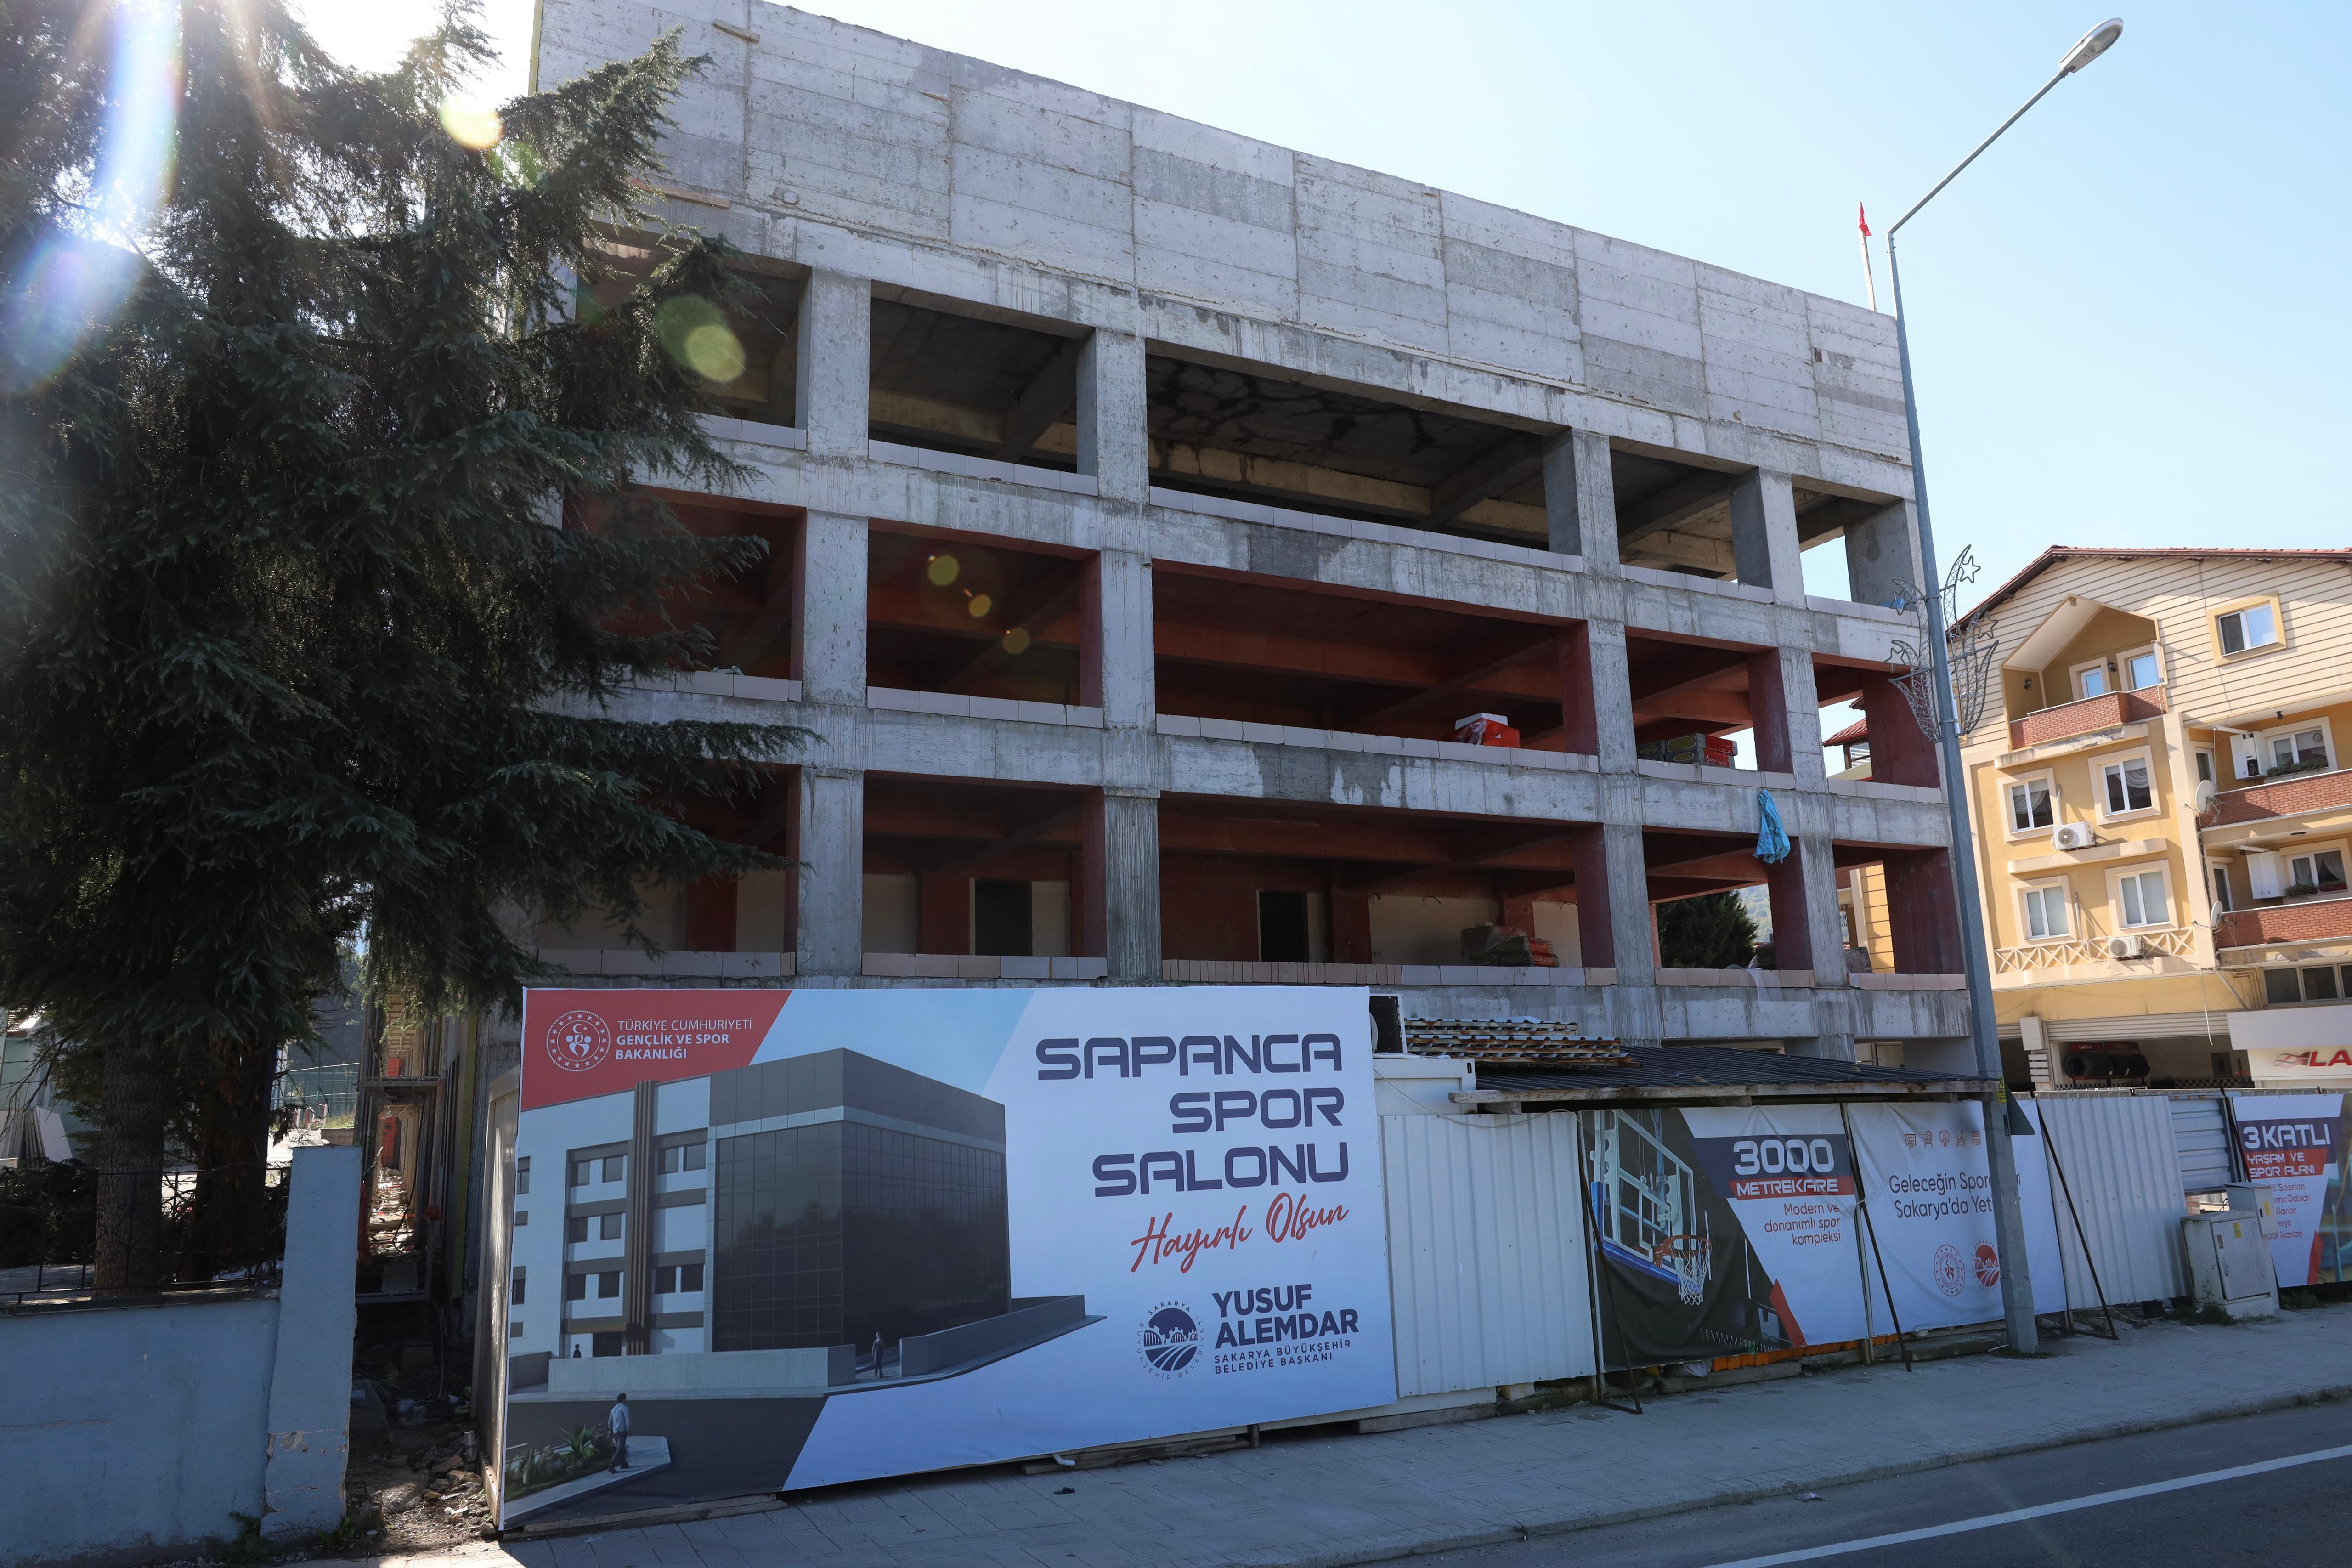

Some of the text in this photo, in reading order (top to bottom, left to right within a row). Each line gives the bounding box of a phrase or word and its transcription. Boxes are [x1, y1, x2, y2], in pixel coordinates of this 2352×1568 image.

[617, 1018, 752, 1030] TÜRKİYE CUMHURİYETİ
[616, 1032, 729, 1047] GENÇLİK VE SPOR
[616, 1046, 687, 1060] BAKANLIĞI
[1036, 1033, 1342, 1080] SAPANCA
[1170, 1087, 1344, 1133] SPOR
[2262, 1123, 2331, 1148] KATLI
[1733, 1139, 1834, 1175] 3000
[2247, 1152, 2305, 1165] YAŞAM VE
[1092, 1142, 1349, 1197] SALONU
[2249, 1164, 2315, 1177] SPOR ALANI
[1736, 1179, 1839, 1196] METREKARE
[1889, 1173, 1956, 1195] Geleceğin
[1784, 1203, 1840, 1216] Modern ve
[1894, 1197, 1968, 1221] Sakarya'da
[1131, 1193, 1350, 1273] Hayırlı Olsun
[1764, 1217, 1840, 1232] donanımlı spor
[1792, 1229, 1841, 1246] kompleksi
[1148, 1300, 1191, 1316] SAKARYA
[1212, 1284, 1312, 1318] YUSUF
[1215, 1309, 1360, 1349] ALEMDAR
[1215, 1339, 1351, 1364] SAKARYA BÜYÜKŞEHİR
[1215, 1352, 1333, 1374] BELEDİYE BAŞKANI
